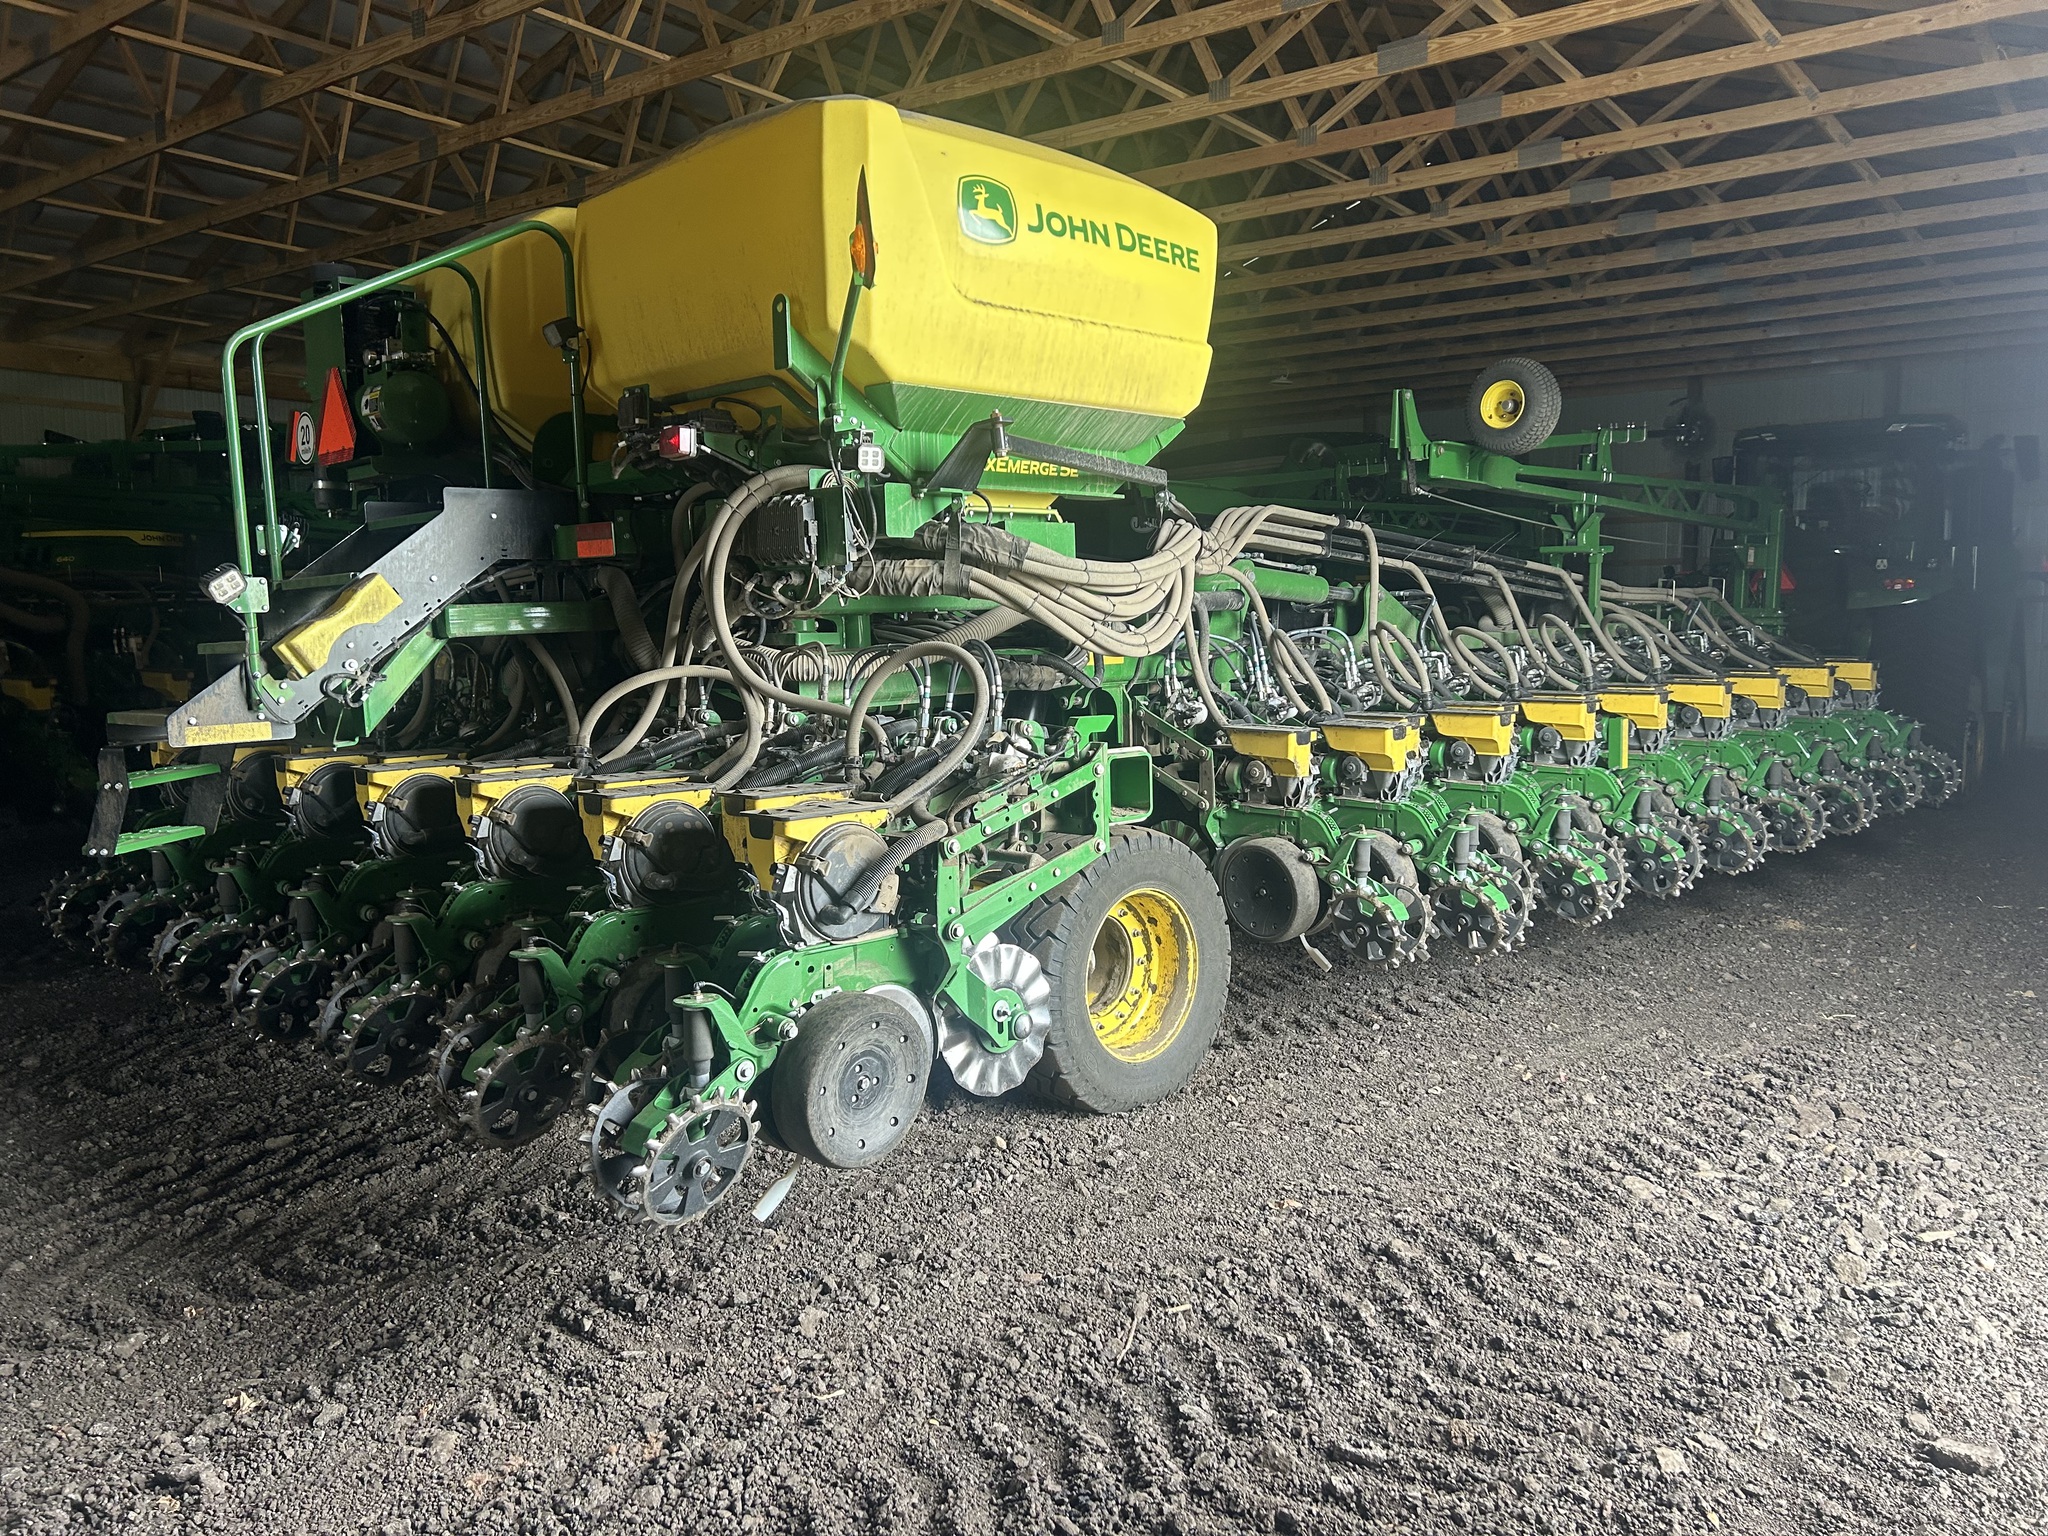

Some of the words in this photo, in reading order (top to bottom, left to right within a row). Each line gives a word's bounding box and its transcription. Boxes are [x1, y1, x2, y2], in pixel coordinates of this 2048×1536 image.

[1028, 204, 1111, 248] JOHN
[1115, 222, 1200, 273] DEERE
[300, 424, 311, 446] 20
[984, 456, 1058, 476] XEMERGE
